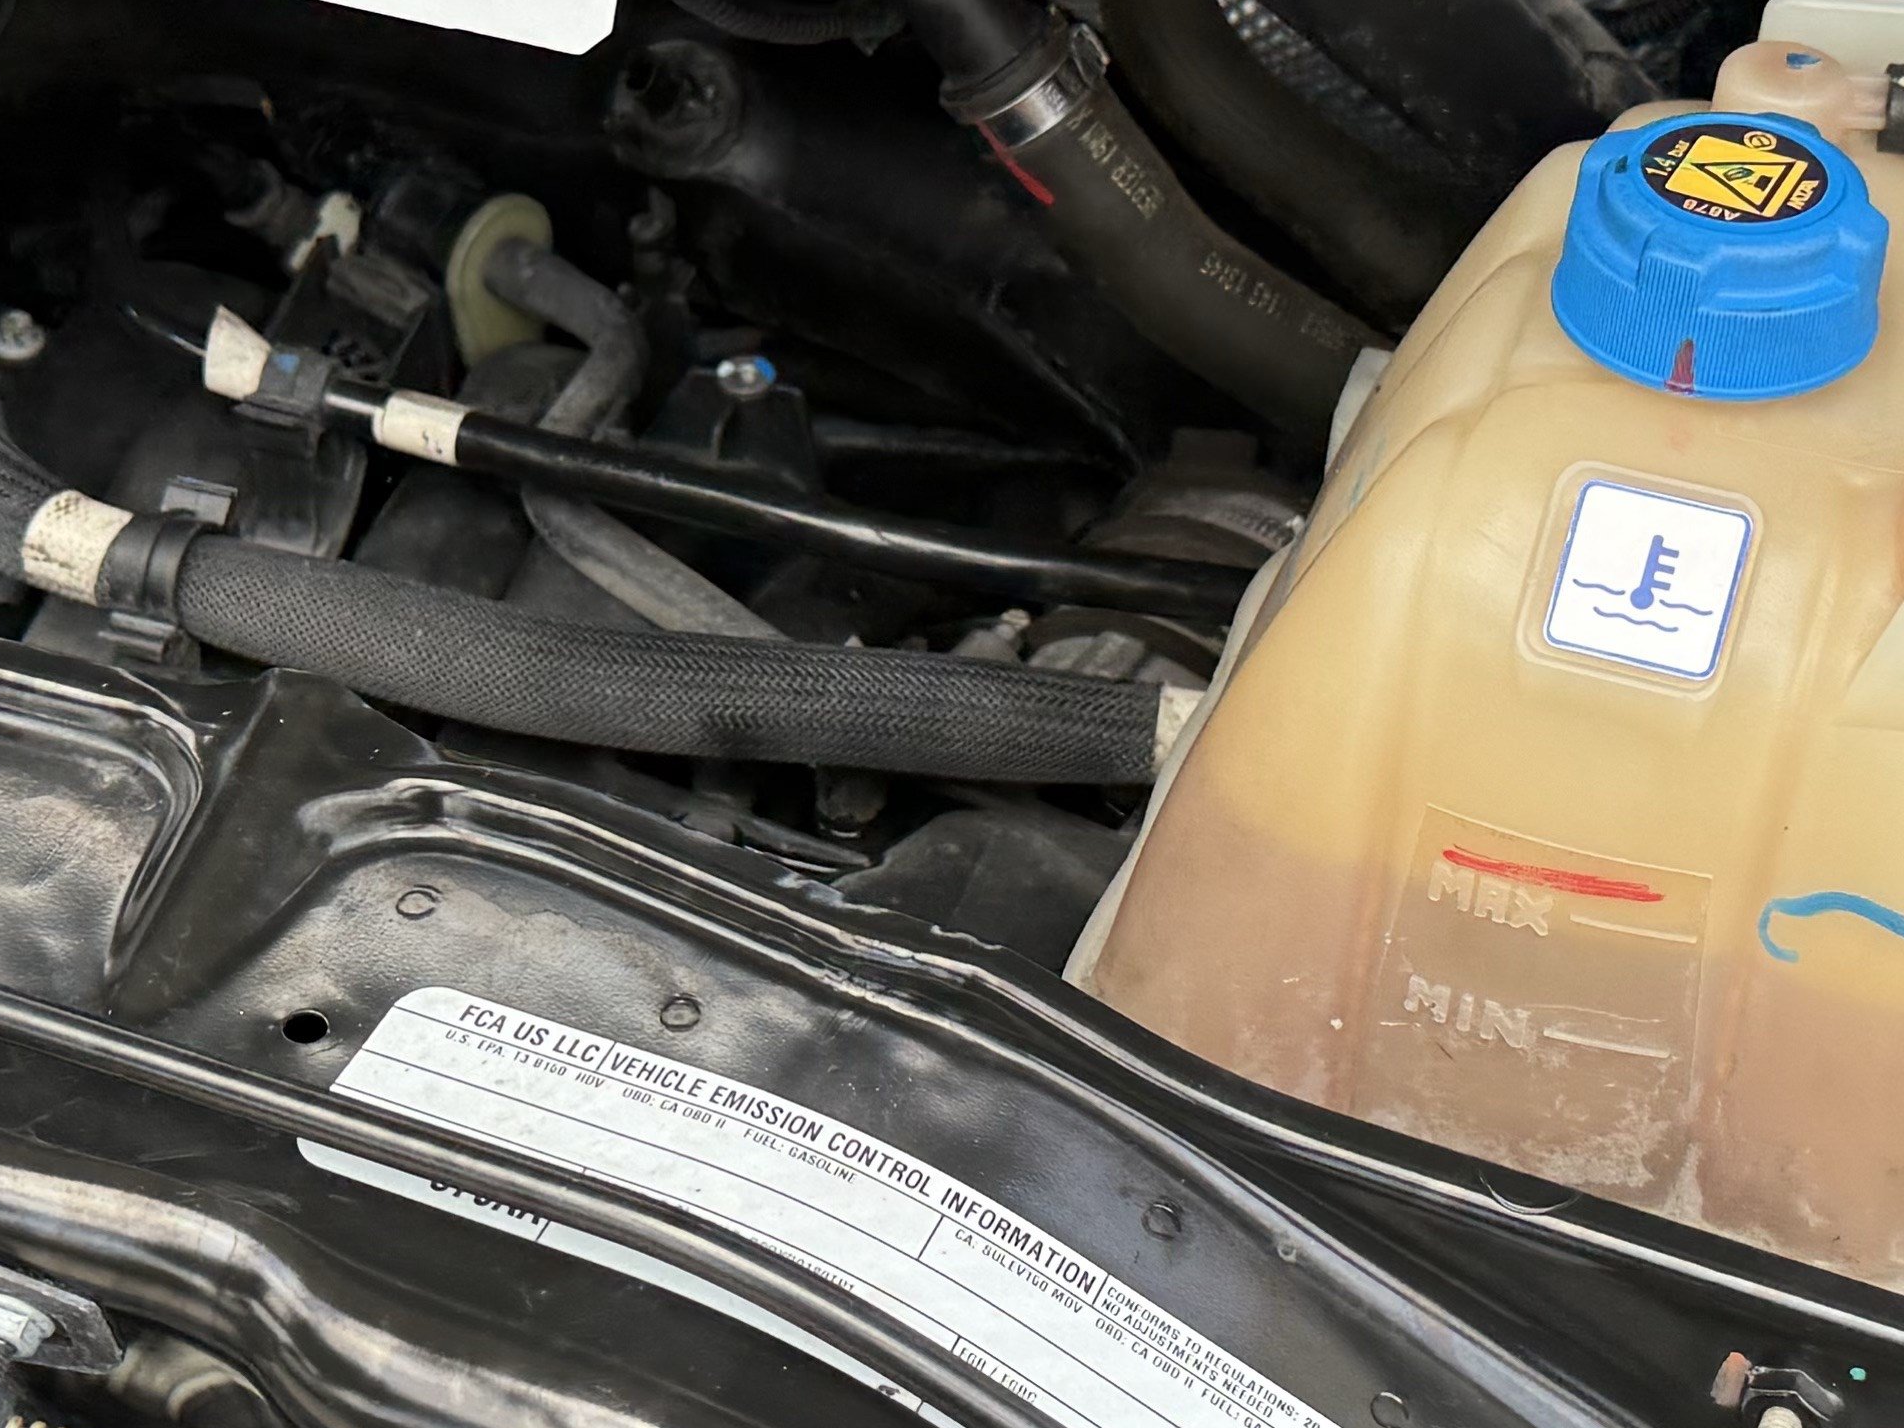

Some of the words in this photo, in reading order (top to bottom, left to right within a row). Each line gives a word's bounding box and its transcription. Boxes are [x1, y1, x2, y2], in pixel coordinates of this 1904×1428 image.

[1646, 156, 1676, 177] 1.4
[1427, 858, 1554, 937] MAX
[1403, 973, 1532, 1049] MIN
[459, 1003, 507, 1034] FCA
[513, 1022, 550, 1047] US
[552, 1034, 601, 1064] LLC
[608, 1051, 708, 1098] VEHICLE
[709, 1084, 825, 1143] EMISSION
[827, 1131, 931, 1198] CONTROL
[939, 1186, 1097, 1295] INFORMATION
[660, 1100, 680, 1115] CA
[682, 1106, 713, 1125] OBD
[742, 1128, 783, 1153] FUEL:
[788, 1146, 858, 1185] GASOLINE
[1100, 1297, 1121, 1317] NO
[1123, 1313, 1219, 1383] ADJUSTMENTS
[1222, 1376, 1274, 1419] NEEDED
[1107, 1285, 1181, 1341] CONFORMS
[1185, 1335, 1202, 1356] TO
[1204, 1350, 1301, 1422] REGULATIONS:
[1130, 1341, 1149, 1361] CA
[1152, 1355, 1182, 1380] OBD
[1200, 1387, 1241, 1421] FUEL:
